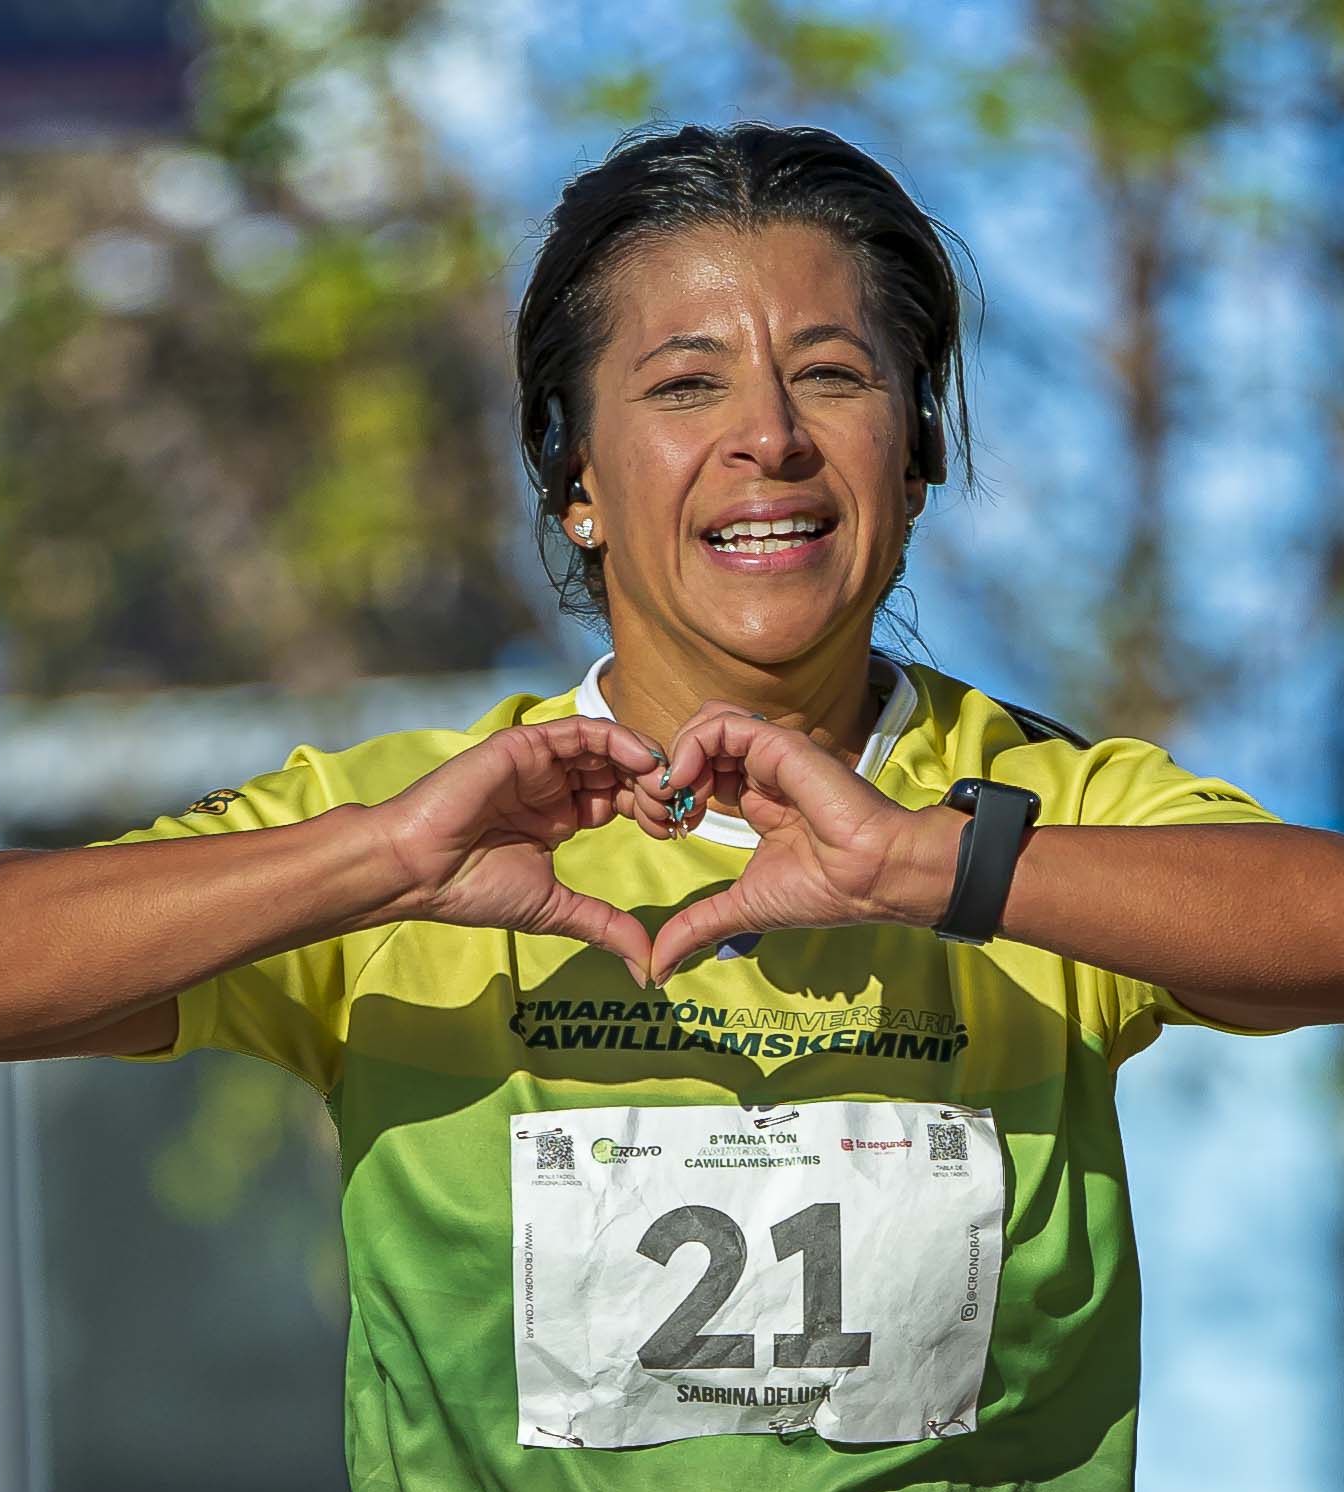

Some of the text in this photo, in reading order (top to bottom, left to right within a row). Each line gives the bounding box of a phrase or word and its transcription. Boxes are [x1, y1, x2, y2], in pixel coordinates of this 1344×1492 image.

[684, 1155, 821, 1168] CAWILLIAMSKEMMIS
[636, 1202, 872, 1369] 21
[966, 1224, 980, 1302] @CRONORAV
[676, 1384, 759, 1406] SABRINA
